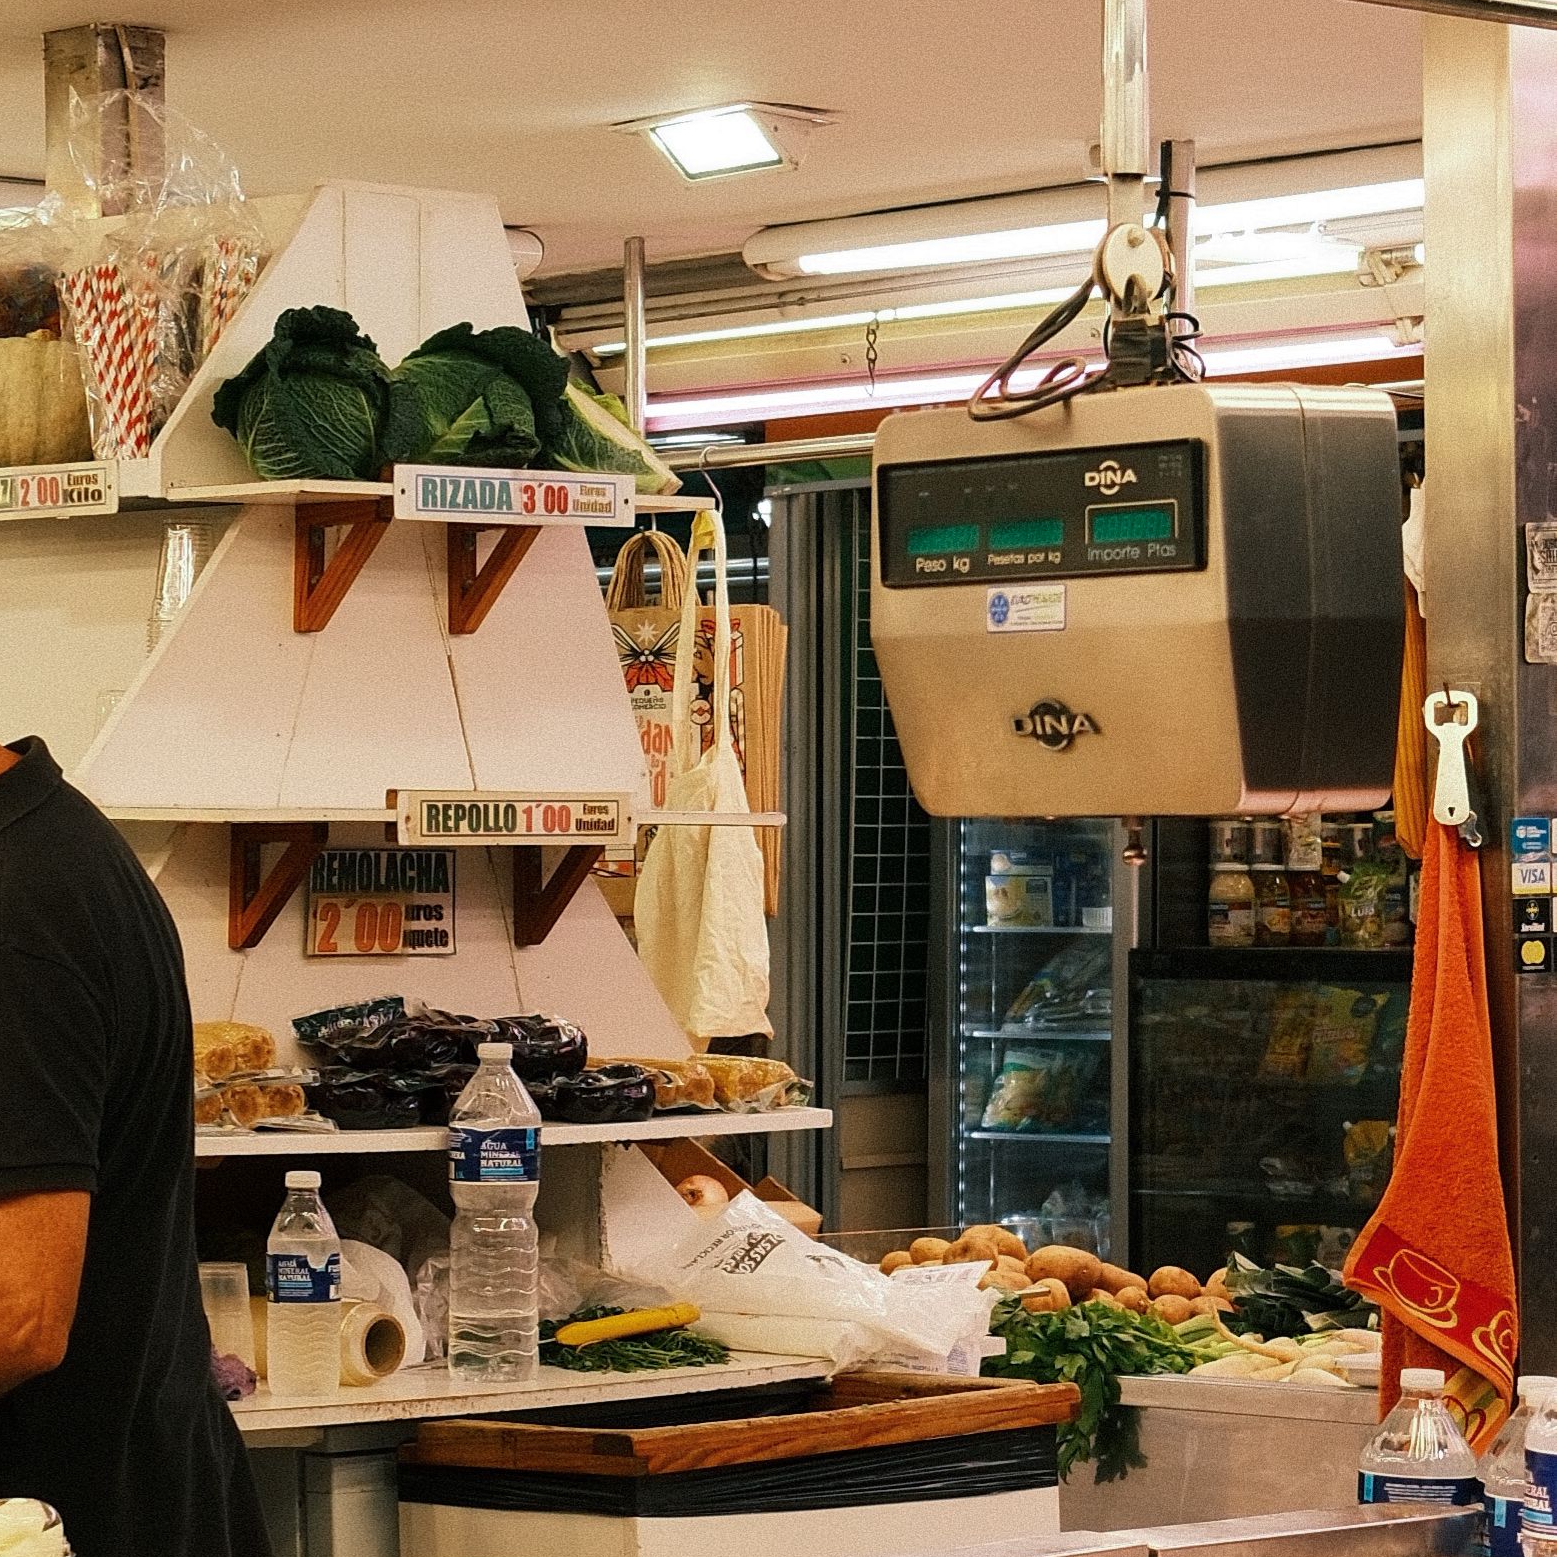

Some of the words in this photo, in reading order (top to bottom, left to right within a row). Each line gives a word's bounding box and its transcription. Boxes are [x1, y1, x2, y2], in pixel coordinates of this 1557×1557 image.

[67, 473, 98, 487] Euros
[1084, 467, 1138, 488] DINA
[421, 477, 513, 511] RIZADA
[579, 484, 607, 497] Euros
[572, 498, 612, 514] Unidad
[1087, 545, 1139, 563] Importe
[1147, 543, 1177, 558] Ptas
[915, 558, 946, 573] Peso
[953, 557, 970, 574] kg
[1012, 713, 1101, 736] DINA
[426, 803, 517, 833] REPOLLO
[582, 803, 610, 816] Euros
[575, 817, 615, 832] Unidad
[312, 852, 450, 893] REMOLACHA
[1520, 869, 1546, 884] VISA
[404, 903, 444, 922] uros
[403, 928, 449, 950] quete
[480, 1141, 507, 1150] AGUA
[480, 1159, 522, 1167] NATURAL
